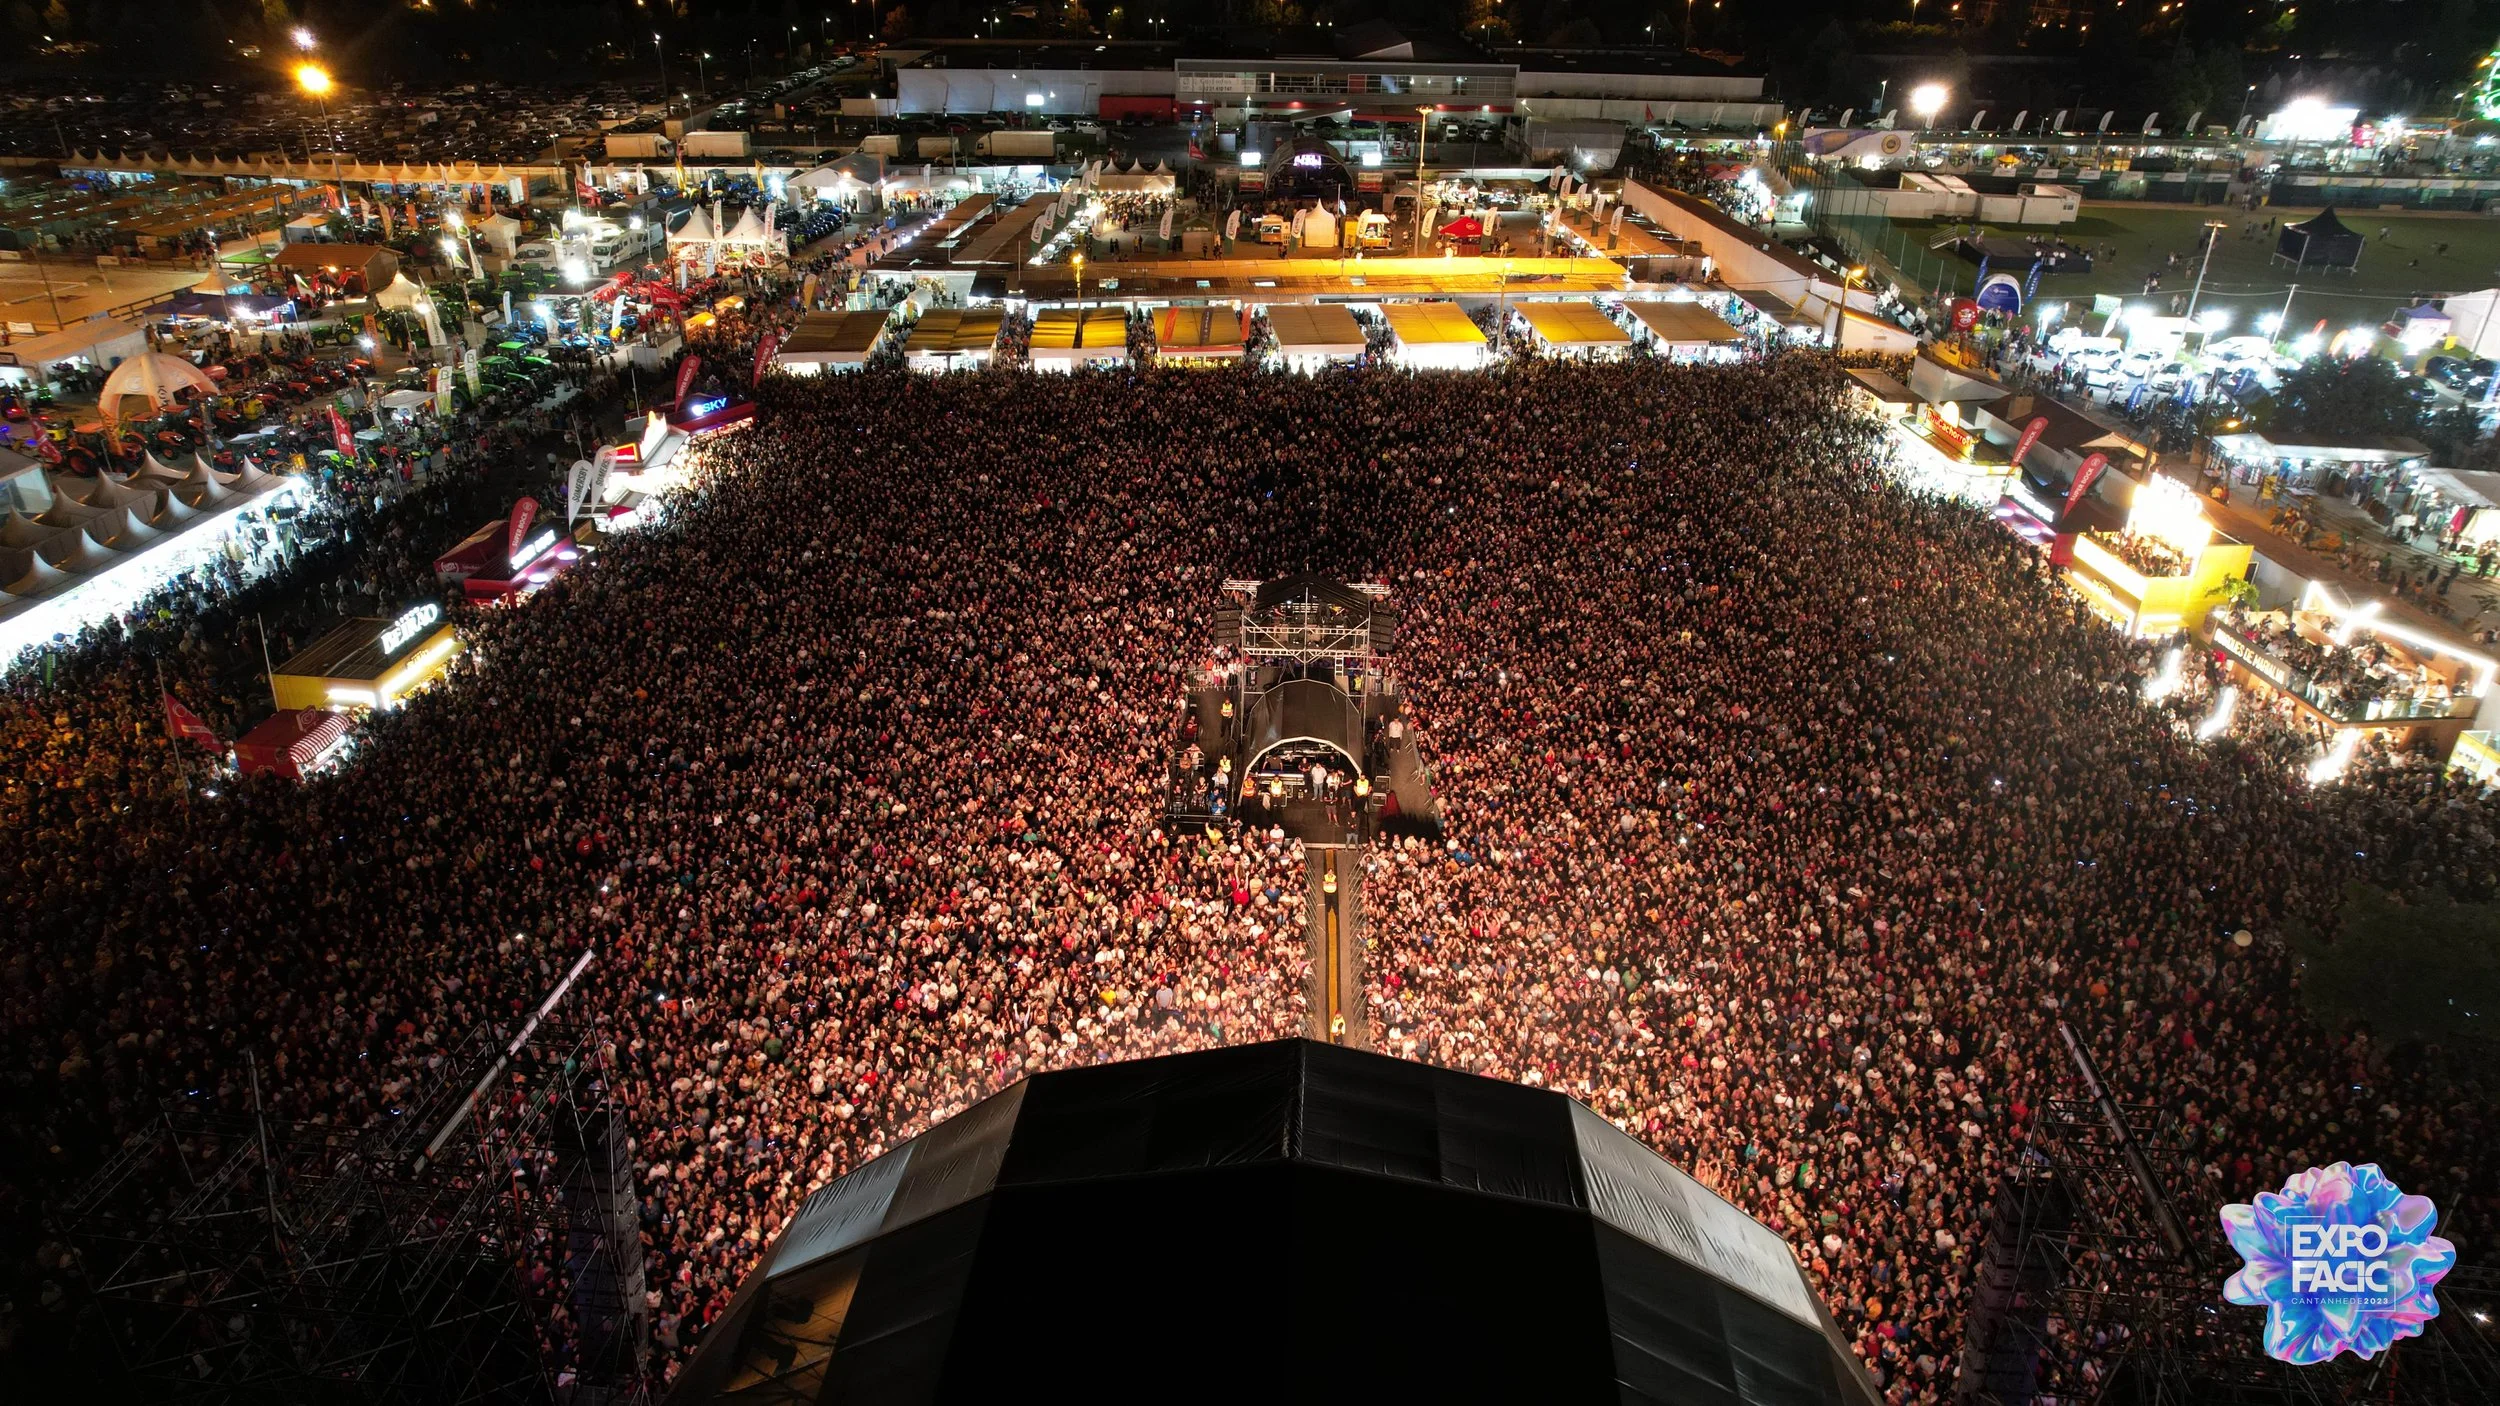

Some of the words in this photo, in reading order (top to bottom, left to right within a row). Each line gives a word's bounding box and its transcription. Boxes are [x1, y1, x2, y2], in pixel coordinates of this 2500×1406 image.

[2014, 446, 2027, 462] SUPER
[2023, 431, 2037, 448] BOCK
[572, 466, 589, 502] SOMERSBY
[2070, 484, 2083, 502] SUPER
[2080, 468, 2094, 486] BOCK
[511, 528, 522, 547] SUPER
[519, 513, 529, 529] BOCK
